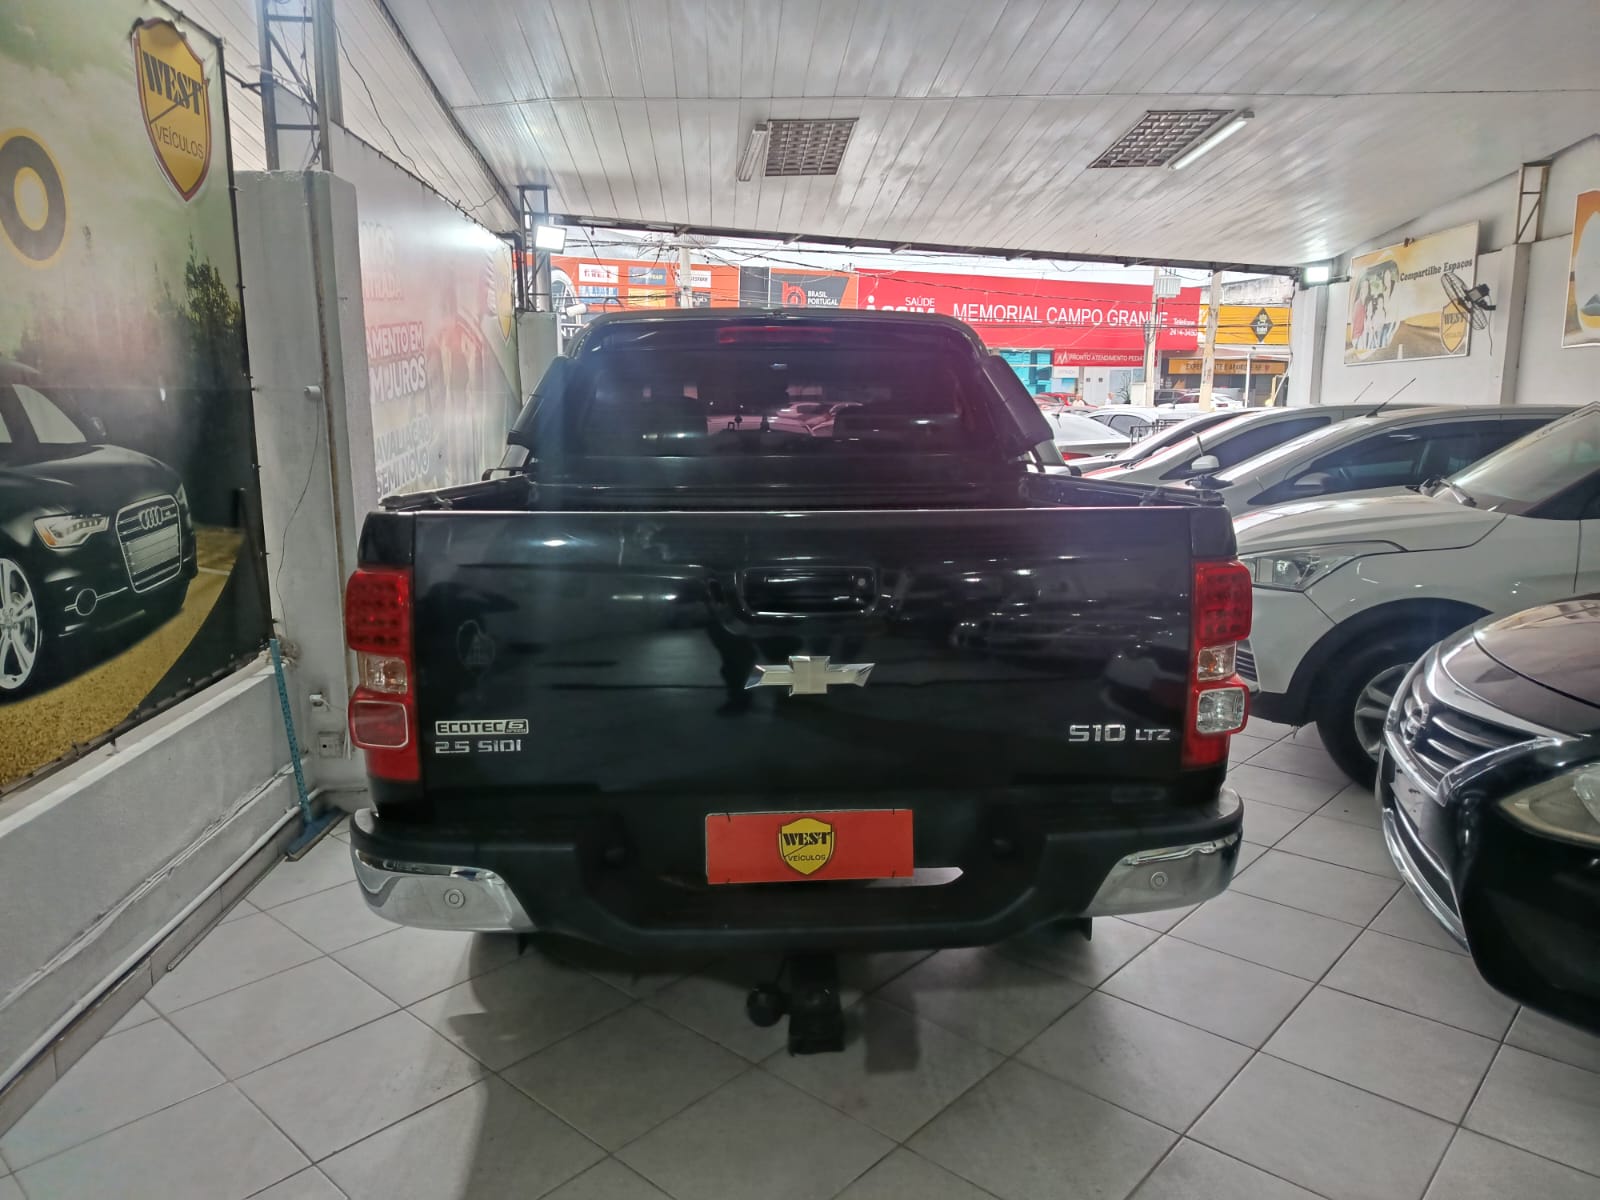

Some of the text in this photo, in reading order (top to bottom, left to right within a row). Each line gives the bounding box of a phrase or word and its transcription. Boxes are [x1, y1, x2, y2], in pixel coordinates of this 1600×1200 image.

[142, 49, 203, 116] WEST
[155, 123, 204, 160] VEÍCULOS
[807, 290, 827, 298] BRASIL
[807, 298, 839, 306] PORTUGAL
[905, 295, 935, 307] SAÚDE
[953, 303, 1042, 324] MEMORIAL
[1046, 306, 1103, 326] CAMPO
[386, 353, 427, 400] JUROS
[437, 722, 504, 734] ECOTEC
[1068, 724, 1171, 742] S10 LTZ
[783, 831, 831, 846] WEST
